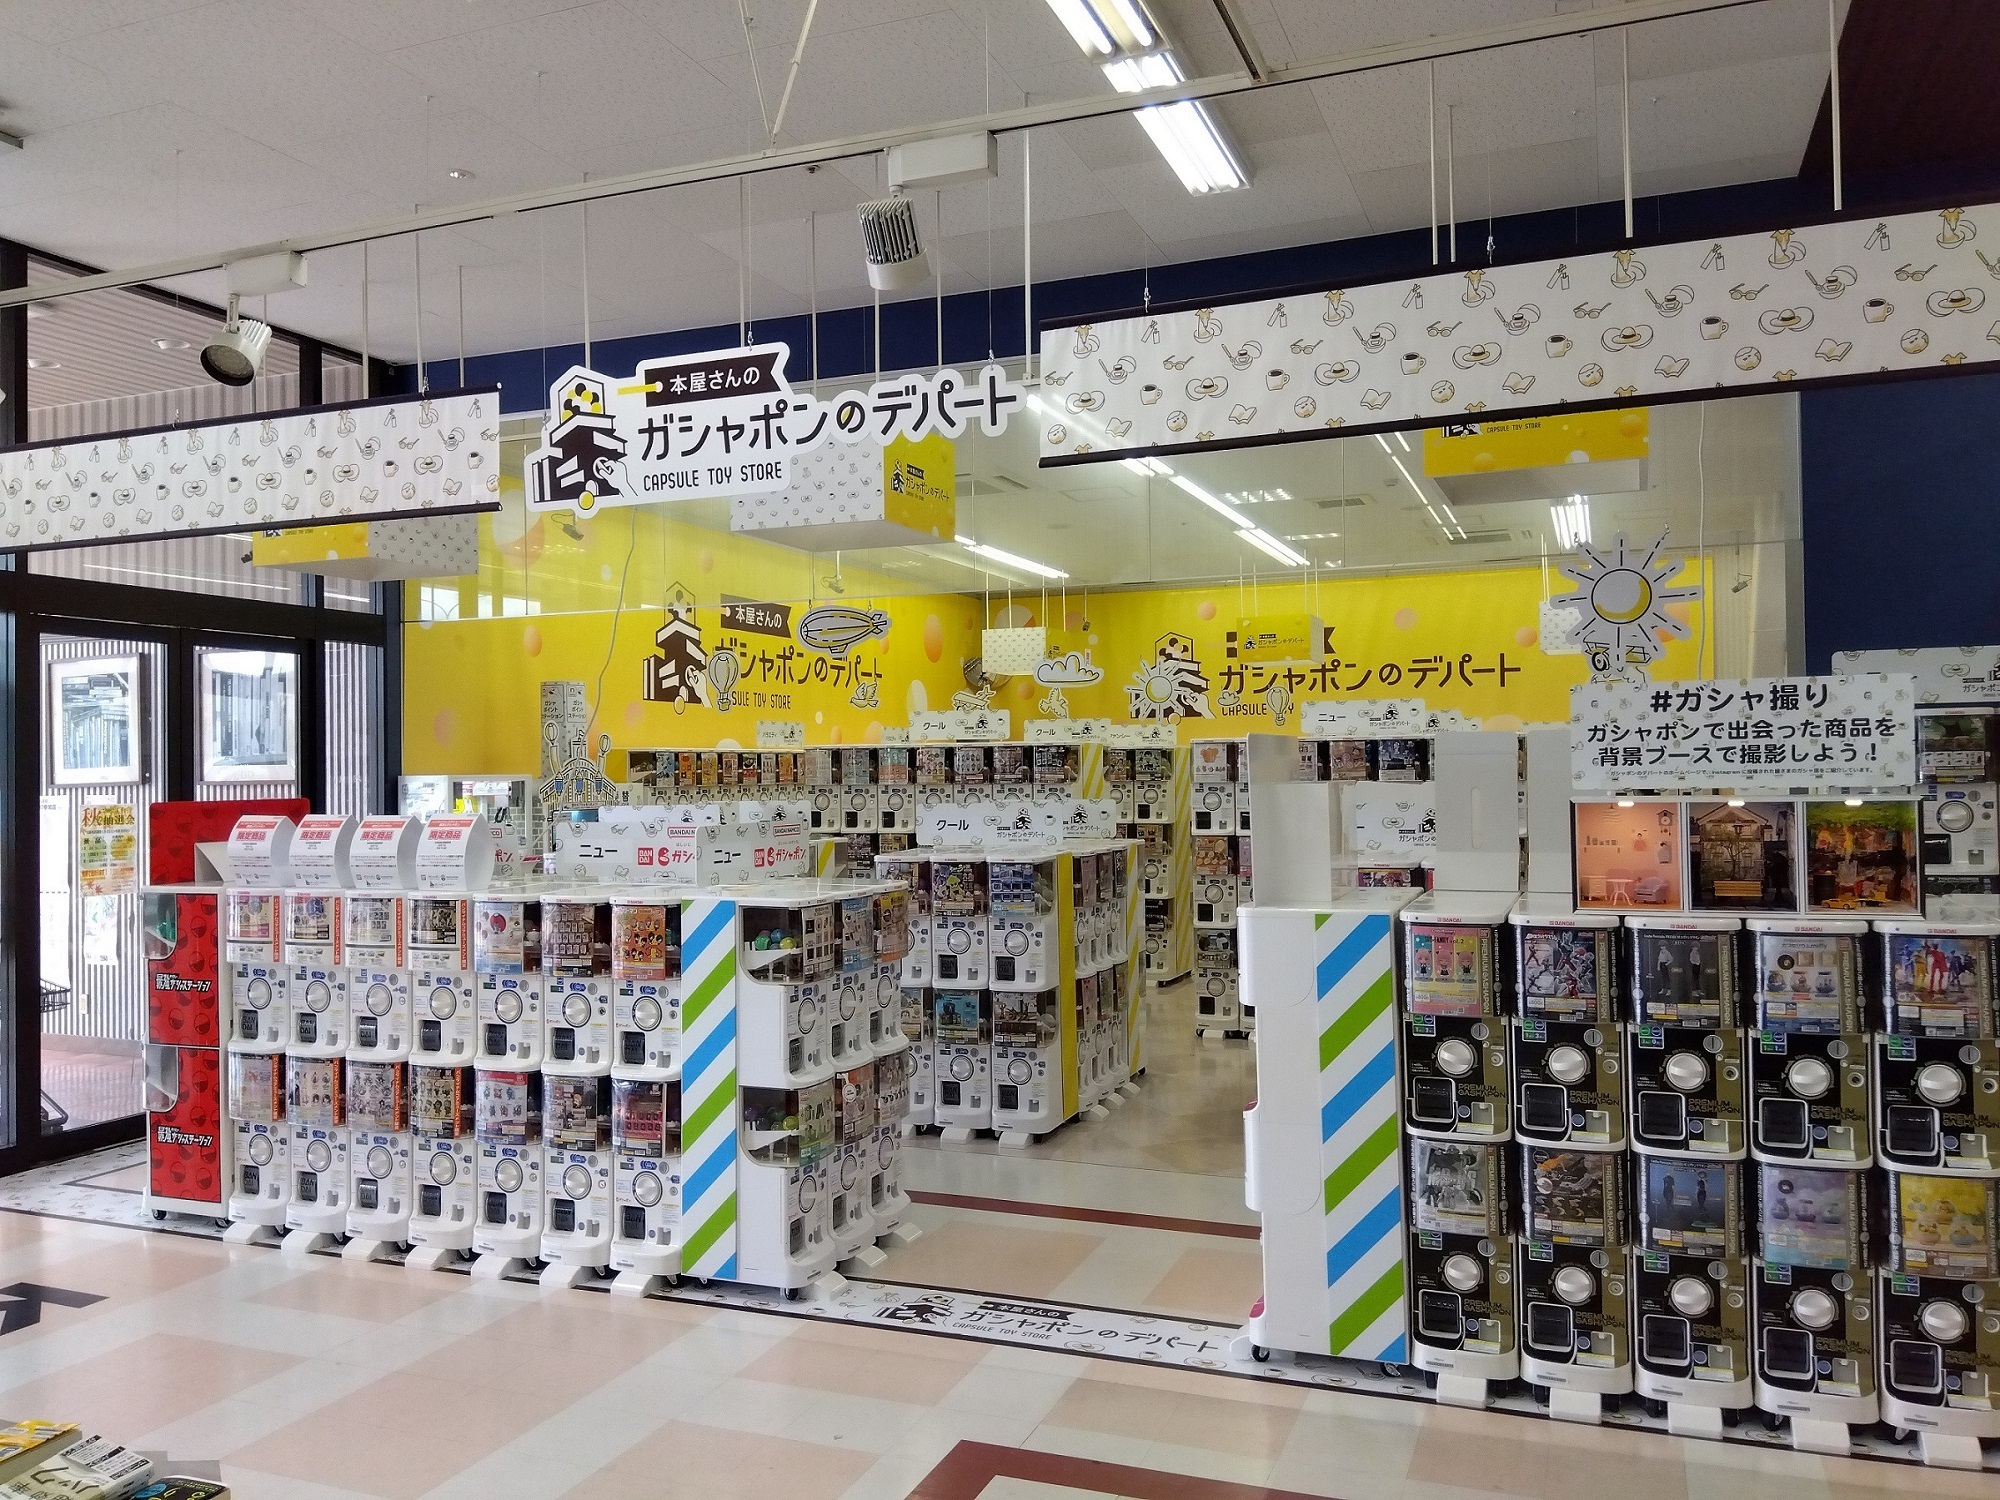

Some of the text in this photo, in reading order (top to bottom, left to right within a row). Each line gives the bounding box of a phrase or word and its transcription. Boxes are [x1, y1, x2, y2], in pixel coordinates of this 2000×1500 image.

[669, 367, 760, 395] 本屋さんの
[638, 376, 1017, 462] ガシャポンのデパート
[1486, 425, 1510, 434] CAPSULE
[1524, 421, 1542, 430] STORE
[643, 461, 783, 492] CAPSULE TOY STORE
[735, 605, 782, 629] 本屋さんの
[1218, 653, 1521, 695] ガシャポンのデパート
[732, 692, 792, 710] SULE TOY STORE
[1650, 683, 1828, 713] #ガシャ撮り
[923, 722, 946, 730] クール
[1318, 713, 1346, 722] ニュー
[1587, 717, 1897, 743] ガシャポンで出会った商品を
[1598, 743, 1878, 767] 背景ブースで撮影しよう！
[936, 819, 970, 831] クール
[579, 844, 618, 858] ニュー
[713, 850, 741, 864] ニュー
[776, 846, 806, 861] ガシャポン
[953, 1322, 1053, 1341] CAPSULE TOY STORE
[963, 1310, 1220, 1352] ガシャポンのデパート
